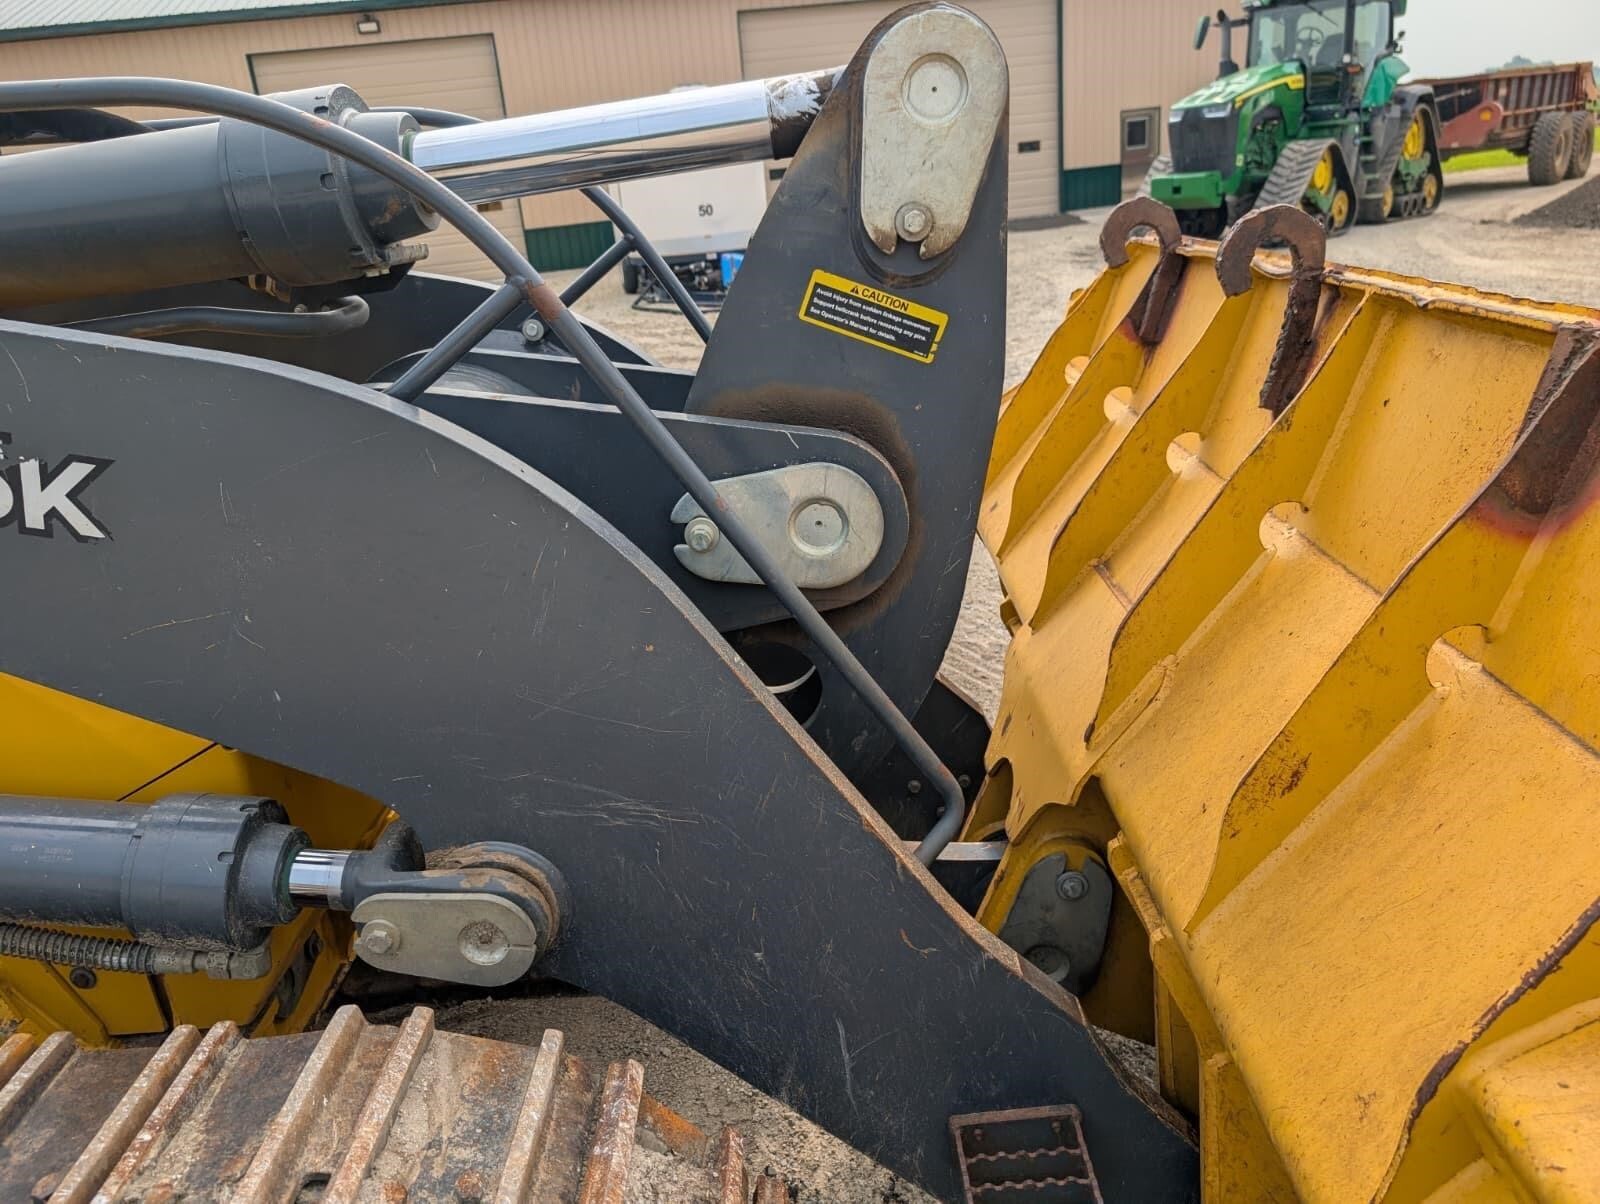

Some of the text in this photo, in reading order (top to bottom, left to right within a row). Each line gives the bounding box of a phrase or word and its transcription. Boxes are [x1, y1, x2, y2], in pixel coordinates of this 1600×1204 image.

[698, 204, 714, 217] 50
[816, 288, 833, 297] Avoid
[833, 294, 849, 303] injury
[849, 298, 862, 307] from
[882, 311, 902, 322] linkage
[861, 288, 910, 312] CAUTION
[810, 306, 821, 315] See
[821, 310, 848, 324] Operator's
[849, 320, 868, 331] Manual
[813, 297, 835, 309] Support
[860, 313, 877, 324] before
[878, 320, 902, 333] removing
[903, 330, 914, 338] any
